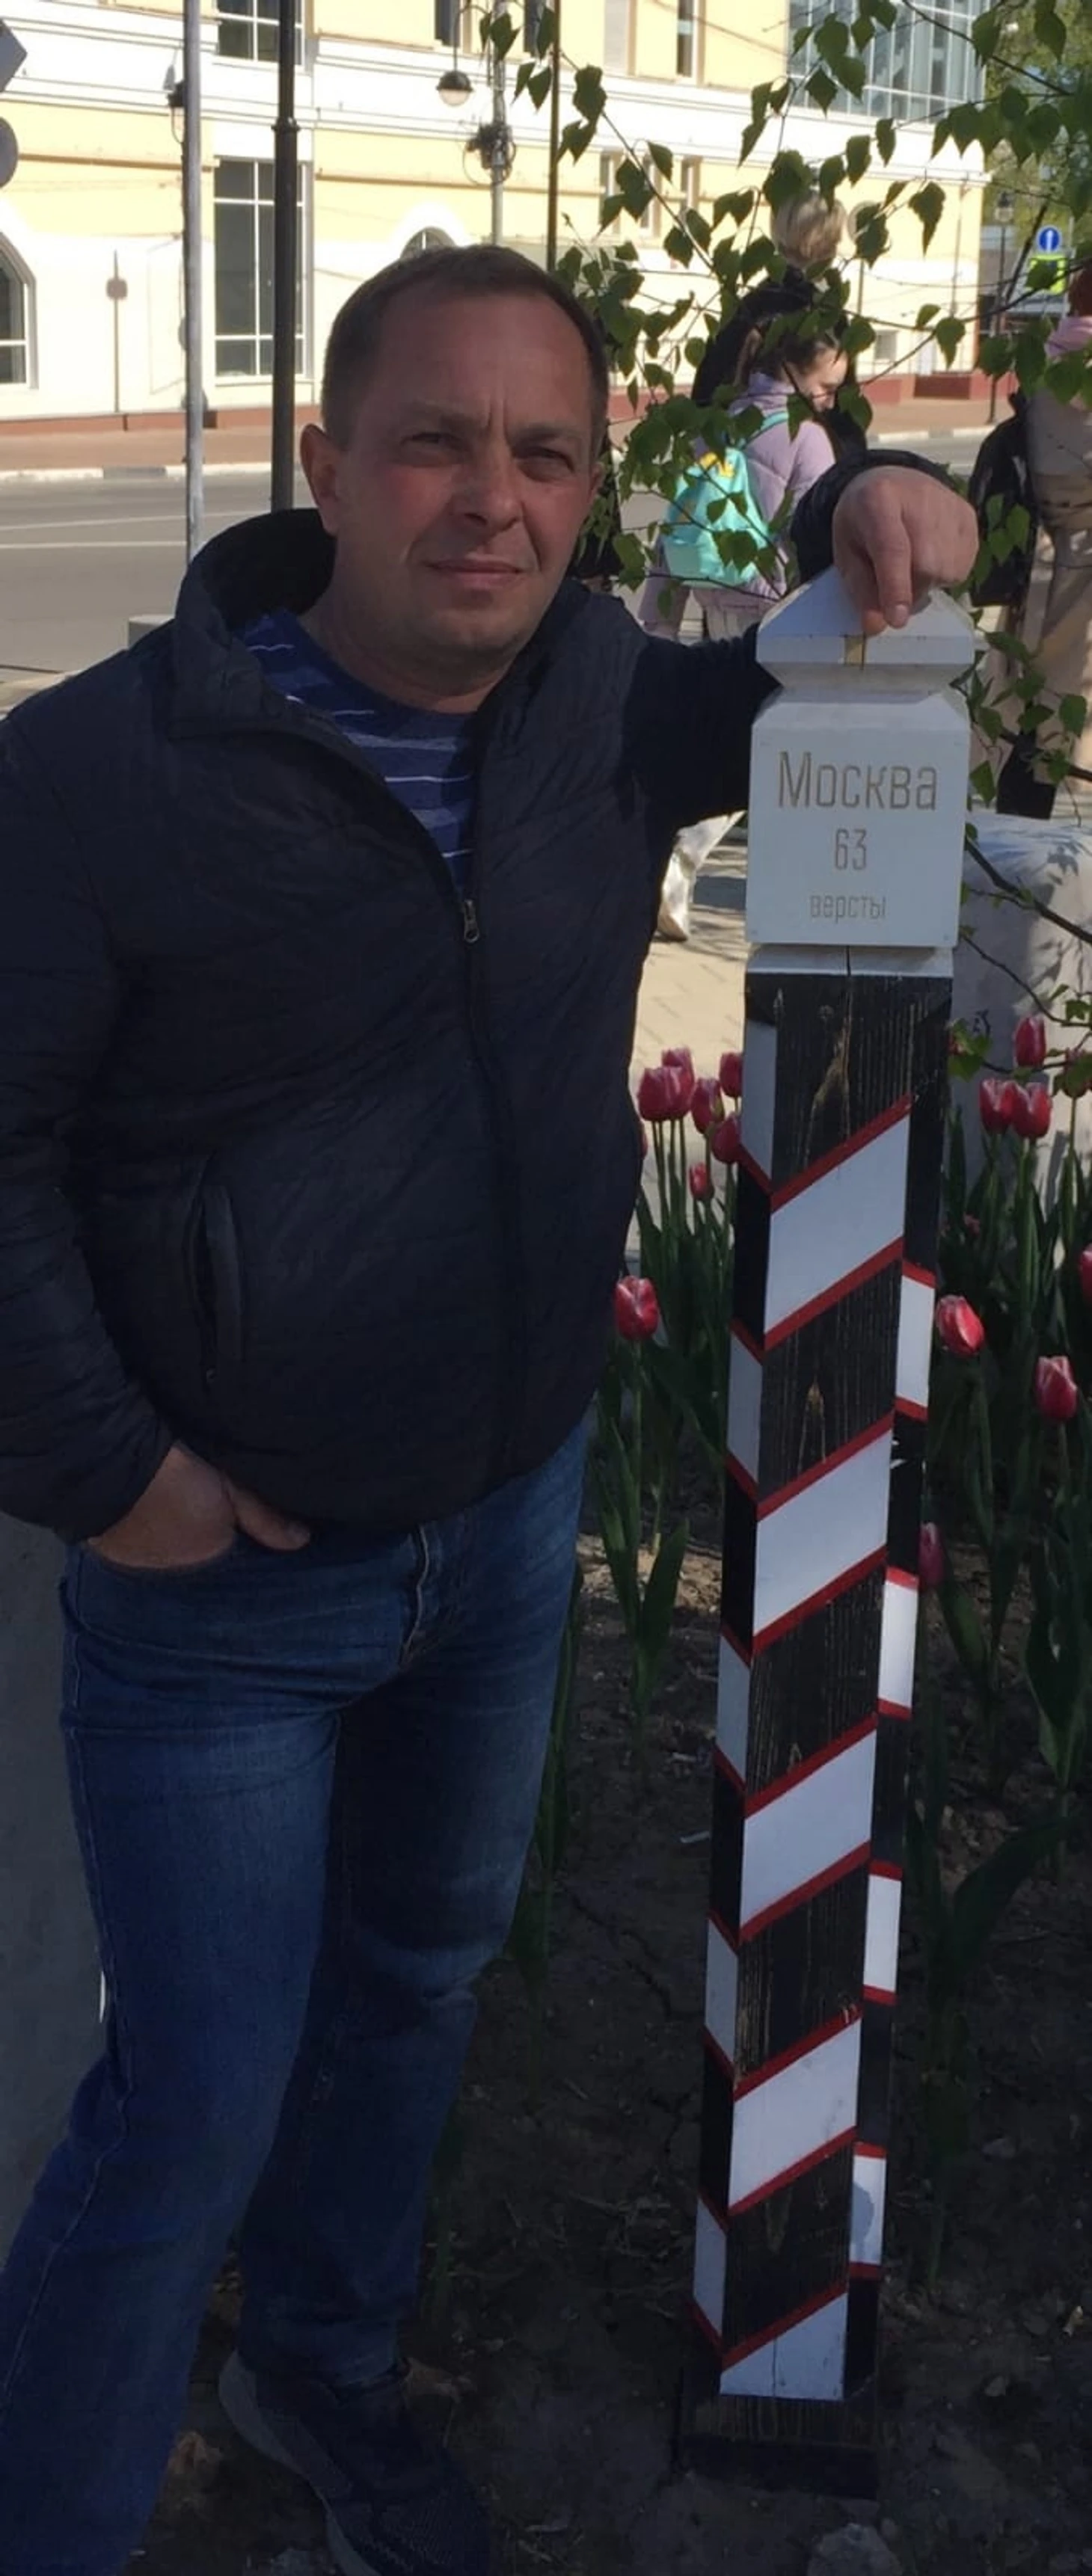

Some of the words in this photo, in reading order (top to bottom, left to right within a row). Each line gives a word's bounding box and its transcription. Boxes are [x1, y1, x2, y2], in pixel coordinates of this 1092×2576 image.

[778, 750, 938, 811] Москва
[834, 827, 868, 871] 63
[809, 894, 887, 924] версты
